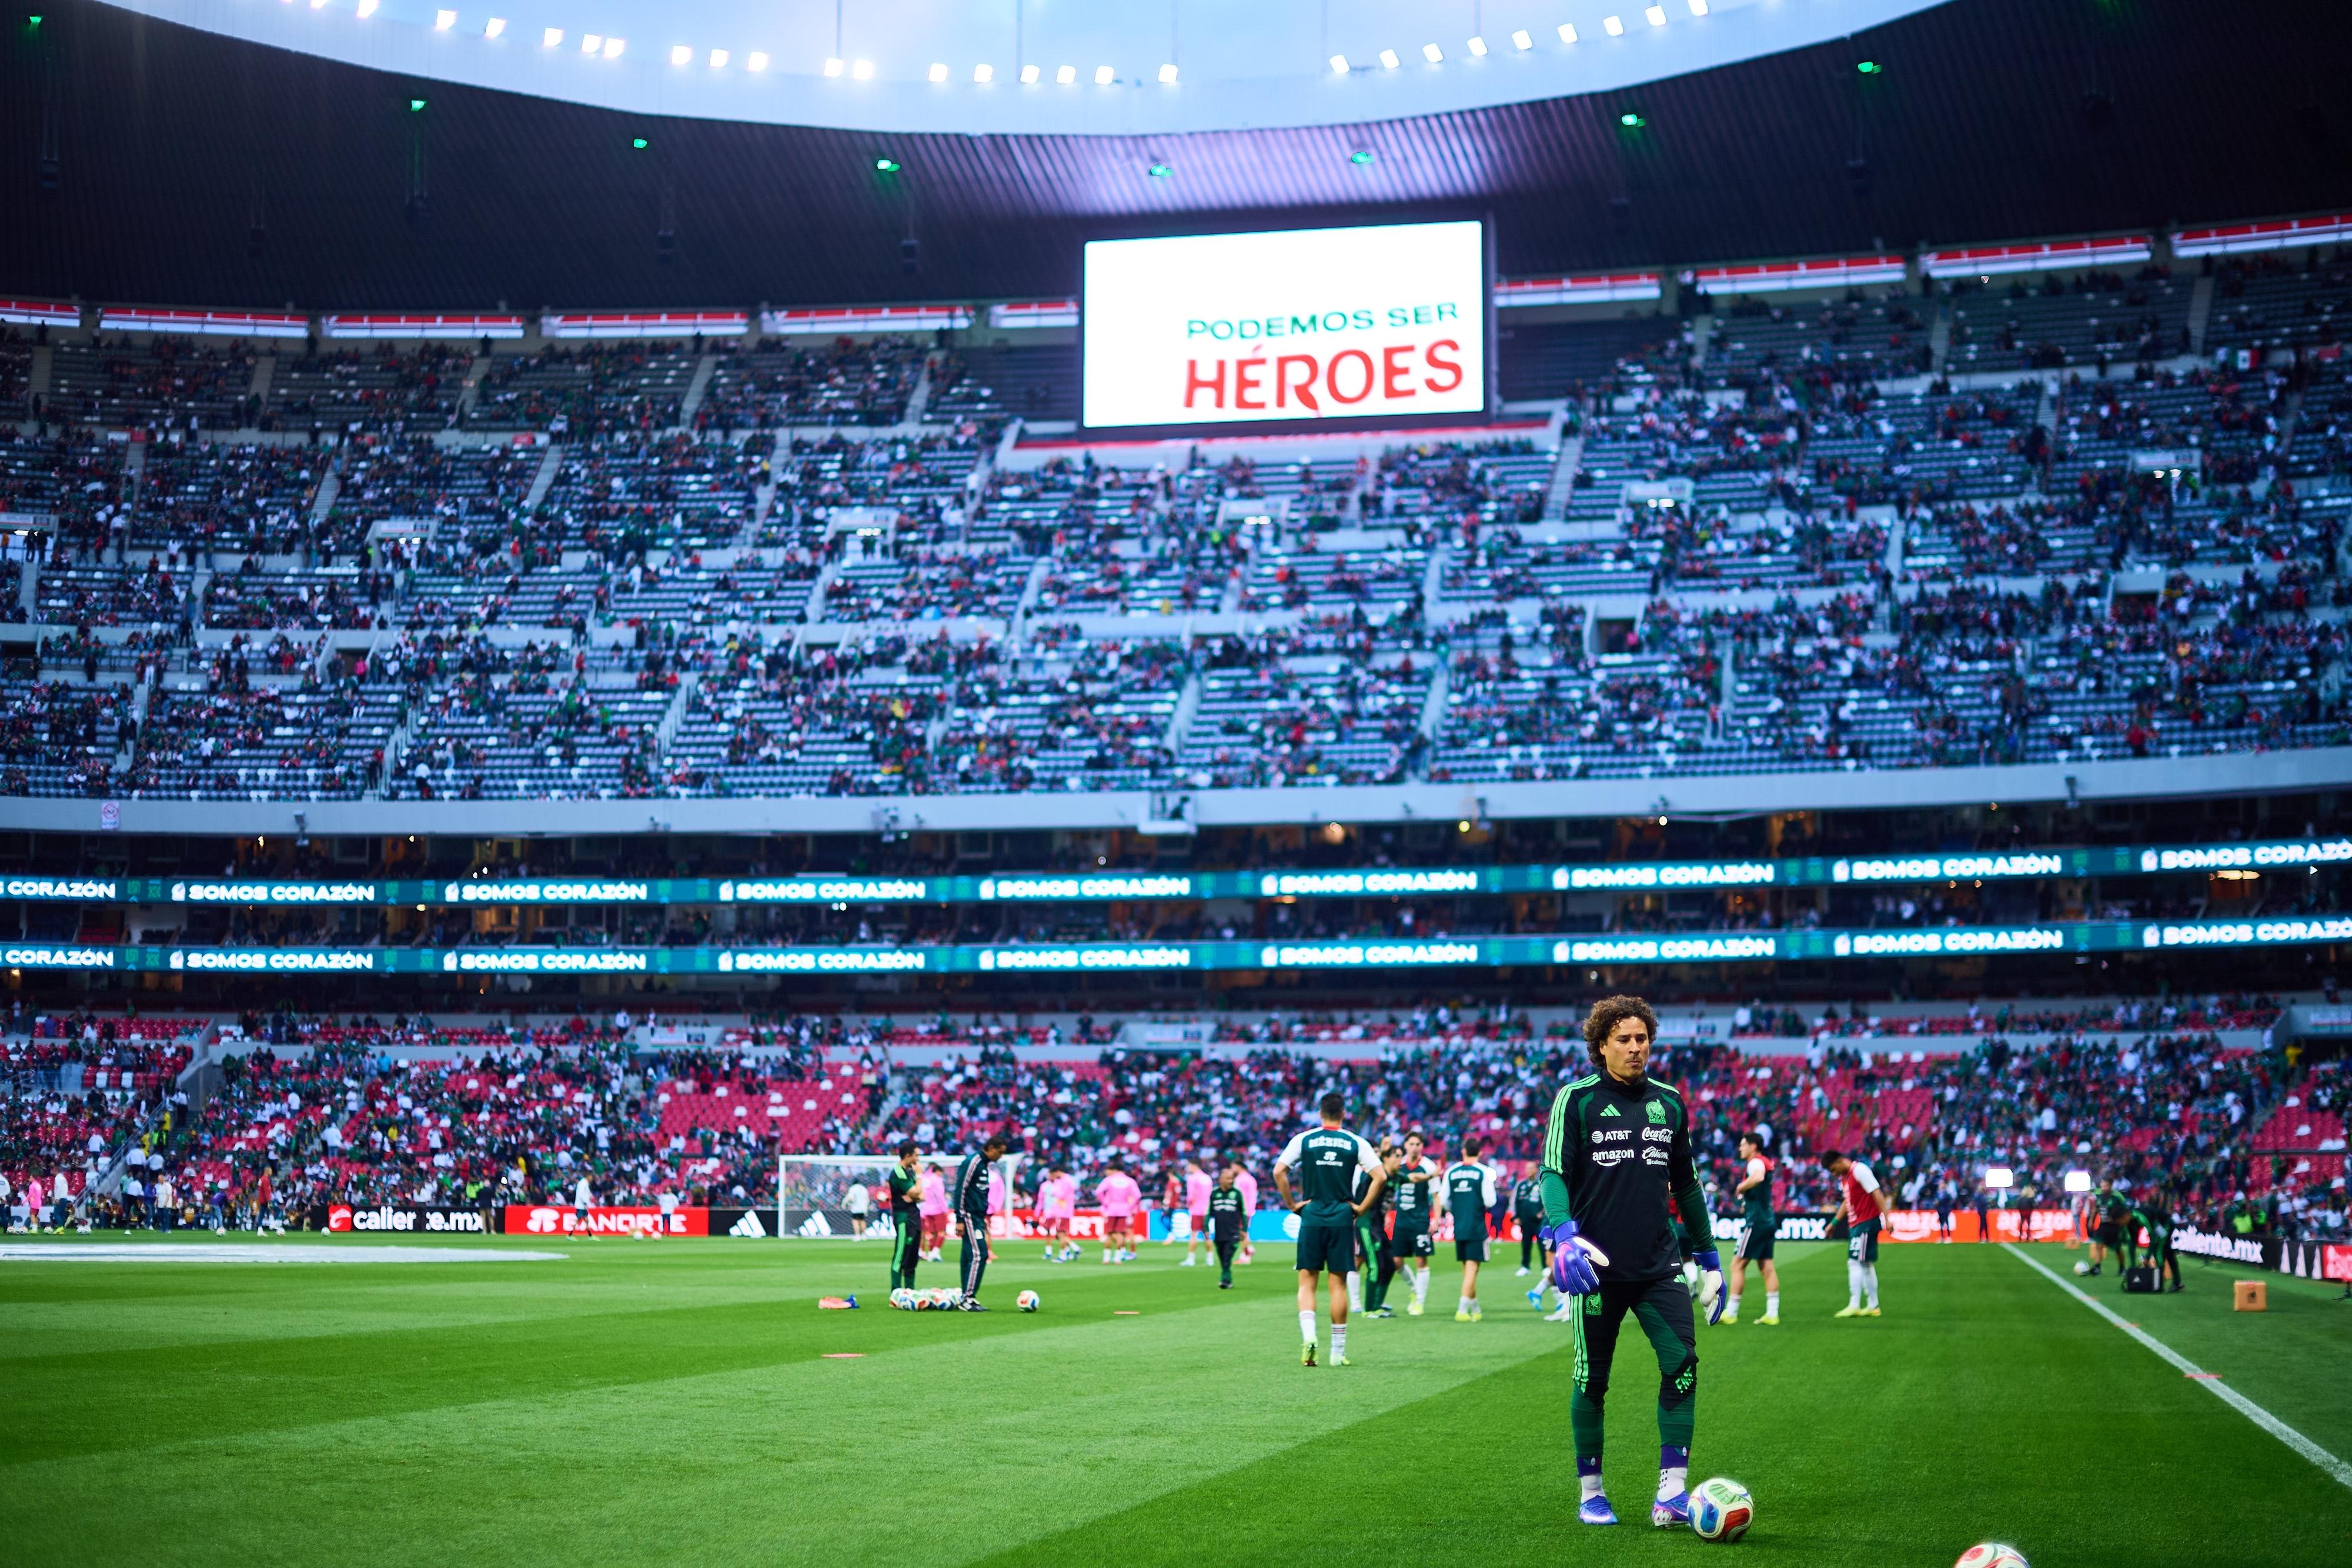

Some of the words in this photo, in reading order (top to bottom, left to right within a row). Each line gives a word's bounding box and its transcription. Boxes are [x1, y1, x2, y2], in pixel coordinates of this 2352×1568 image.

[1187, 309, 1374, 340] PODEMOS
[1388, 302, 1458, 329] SER
[1184, 338, 1463, 415] HÉROES
[2161, 848, 2251, 868] SOMOS
[2254, 841, 2352, 864] CORAZÓ
[1572, 868, 1658, 887] SOMOS
[1659, 863, 1774, 884] CORAZÓN
[1852, 860, 1940, 879] SOMOS
[1943, 855, 2061, 876] CORAZÓN
[7, 880, 116, 898] CORAZÓN
[189, 885, 268, 900] SOMOS
[271, 883, 375, 901] CORAZÓN
[462, 884, 540, 900] SOMOS
[543, 882, 647, 900] CORAZÓN
[736, 883, 816, 900] SOMOS
[818, 880, 925, 899] CORAZÓN
[997, 880, 1079, 897] SOMOS
[1080, 877, 1190, 896] CORAZÓN
[1279, 874, 1364, 897] SOMOS
[1365, 871, 1477, 891] CORAZÓN
[1853, 934, 1942, 953] SOMOS
[1944, 929, 2063, 951] CORAZÓN
[2163, 925, 2254, 945] SOMOS
[2256, 919, 2352, 941] CORAZÓ
[5, 948, 113, 966] CORAZÓN
[997, 951, 1079, 968] SOMOS
[1080, 948, 1190, 967] CORAZÓN
[1279, 947, 1364, 965] SOMOS
[1365, 943, 1478, 964] CORAZÓN
[1572, 941, 1658, 960] SOMOS
[1660, 937, 1775, 958] CORAZÓN
[187, 953, 266, 968] SOMOS
[269, 951, 373, 969] CORAZÓN
[460, 954, 539, 969] SOMOS
[541, 952, 646, 969] CORAZÓN
[736, 954, 816, 969] SOMOS
[817, 951, 925, 969] CORAZÓN
[1605, 1130, 1632, 1141] AT&T
[1592, 1149, 1635, 1161] amazon
